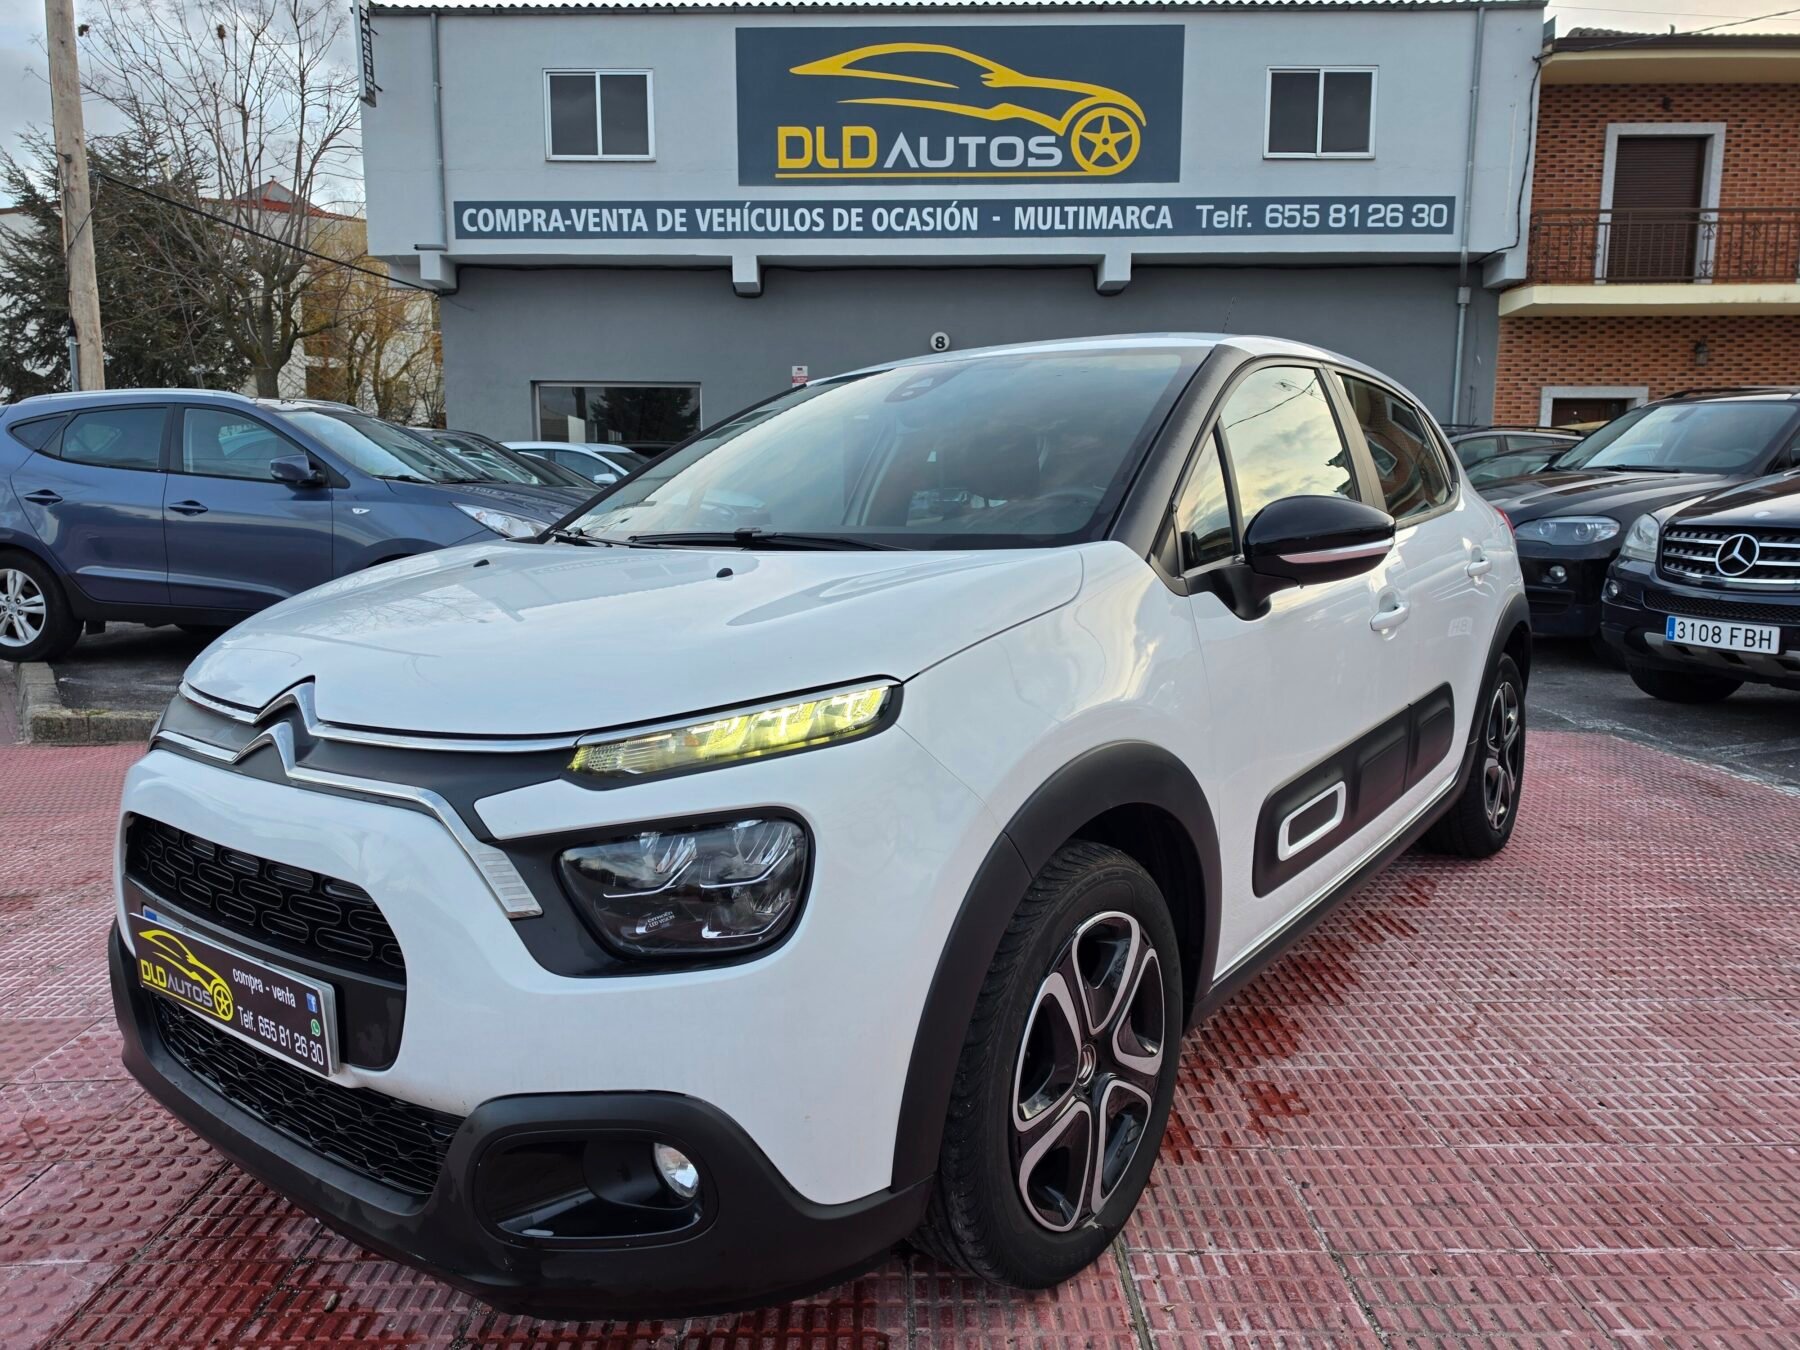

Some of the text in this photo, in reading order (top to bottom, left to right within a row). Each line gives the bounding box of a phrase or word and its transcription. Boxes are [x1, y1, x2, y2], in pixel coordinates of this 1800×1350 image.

[777, 126, 1063, 169] DLD AUTOS
[462, 208, 649, 232] COMPRA-VENTA
[657, 208, 688, 232] DE
[695, 202, 825, 232] VEHÍCULOS
[833, 208, 864, 231] DE
[872, 201, 978, 231] OCASIÓN
[1014, 205, 1173, 231] MULTIMARCA
[1196, 203, 1448, 229] Telf. 655 81 26 30
[935, 335, 946, 350] 8
[1677, 621, 1772, 650] 3108 FBH
[140, 958, 213, 1008] DLD AUTOS
[232, 967, 264, 995] compra
[271, 984, 297, 1009] venta
[237, 1004, 324, 1066] Telf. 655 81 26 30
